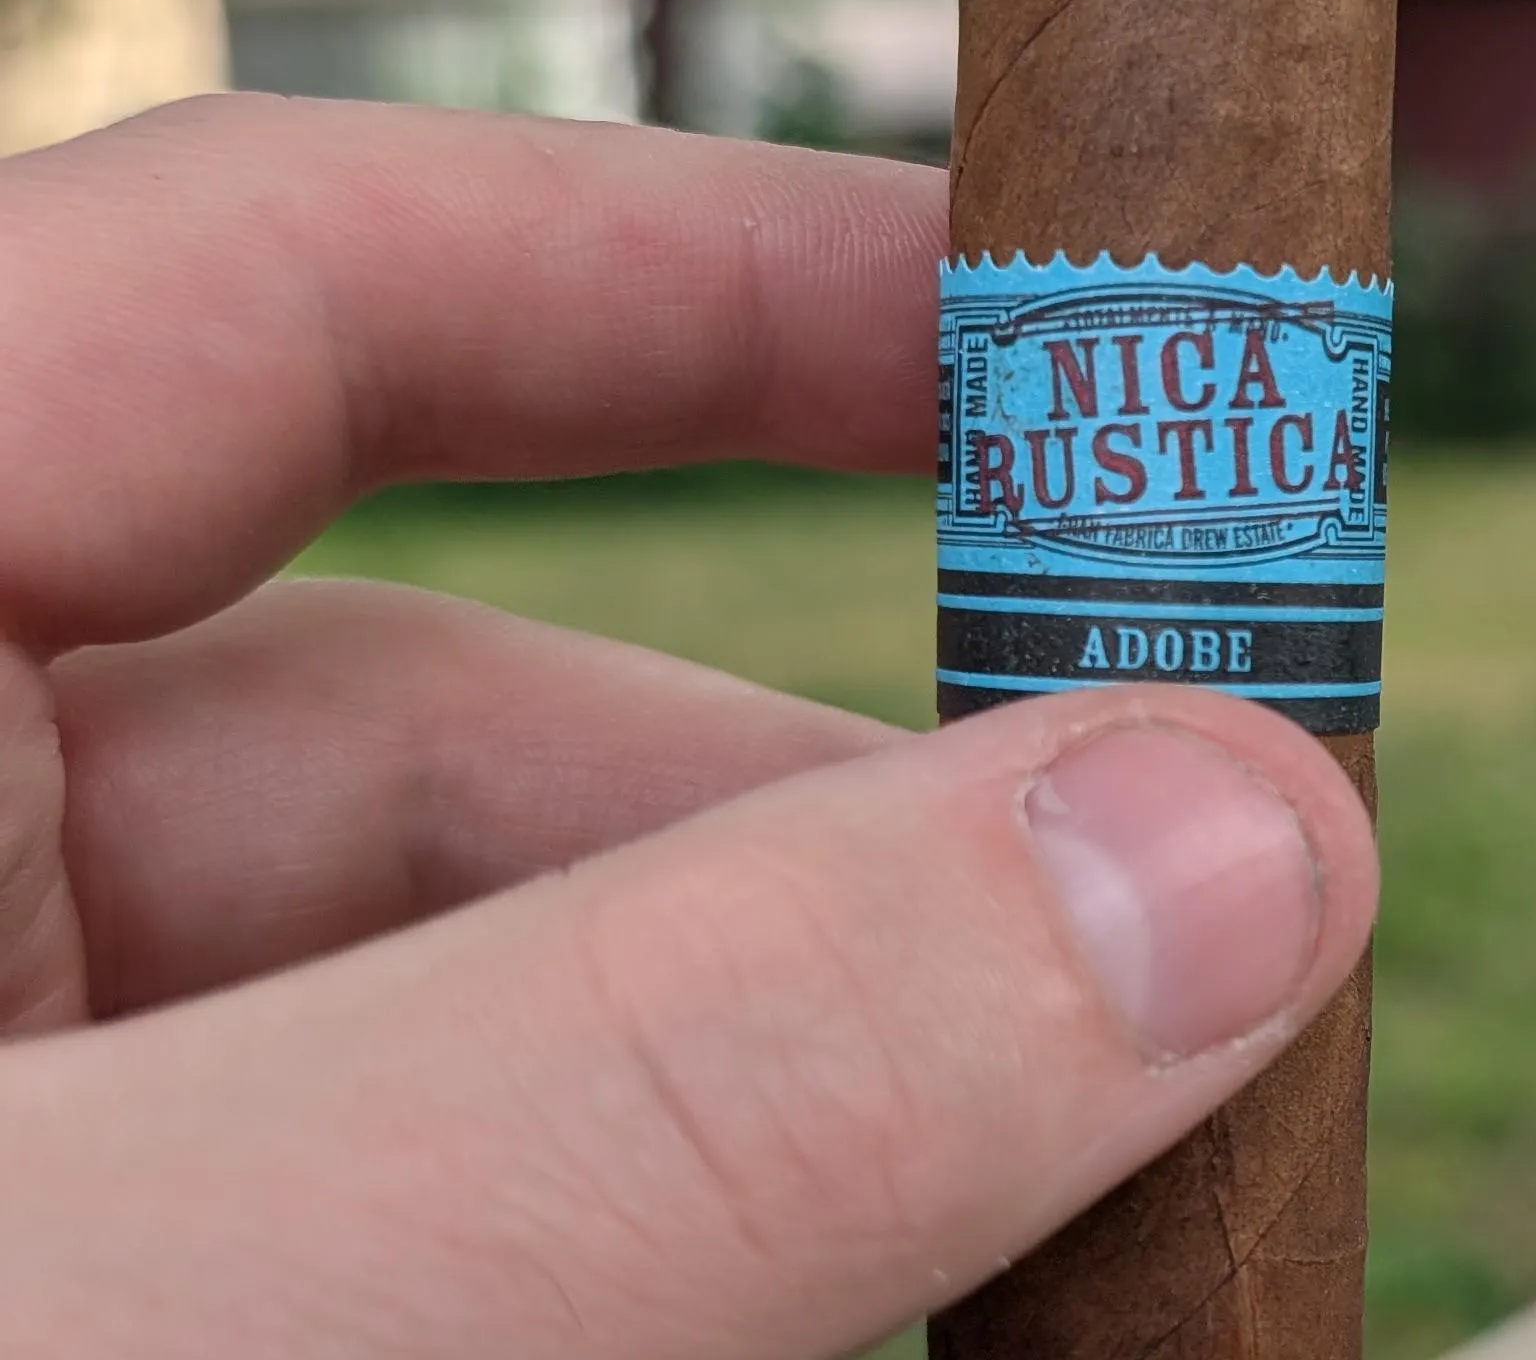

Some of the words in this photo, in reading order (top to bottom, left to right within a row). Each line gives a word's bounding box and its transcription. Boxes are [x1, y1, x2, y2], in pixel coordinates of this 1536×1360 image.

[964, 337, 989, 418] MADE
[1043, 326, 1286, 422] NICA
[1350, 358, 1369, 434] HAND
[975, 409, 1359, 515] RUSTICA
[1104, 526, 1174, 550] FABRICA
[1180, 527, 1228, 551] DREW
[1232, 520, 1286, 549] ESTATE
[1078, 623, 1254, 674] ADOBE
